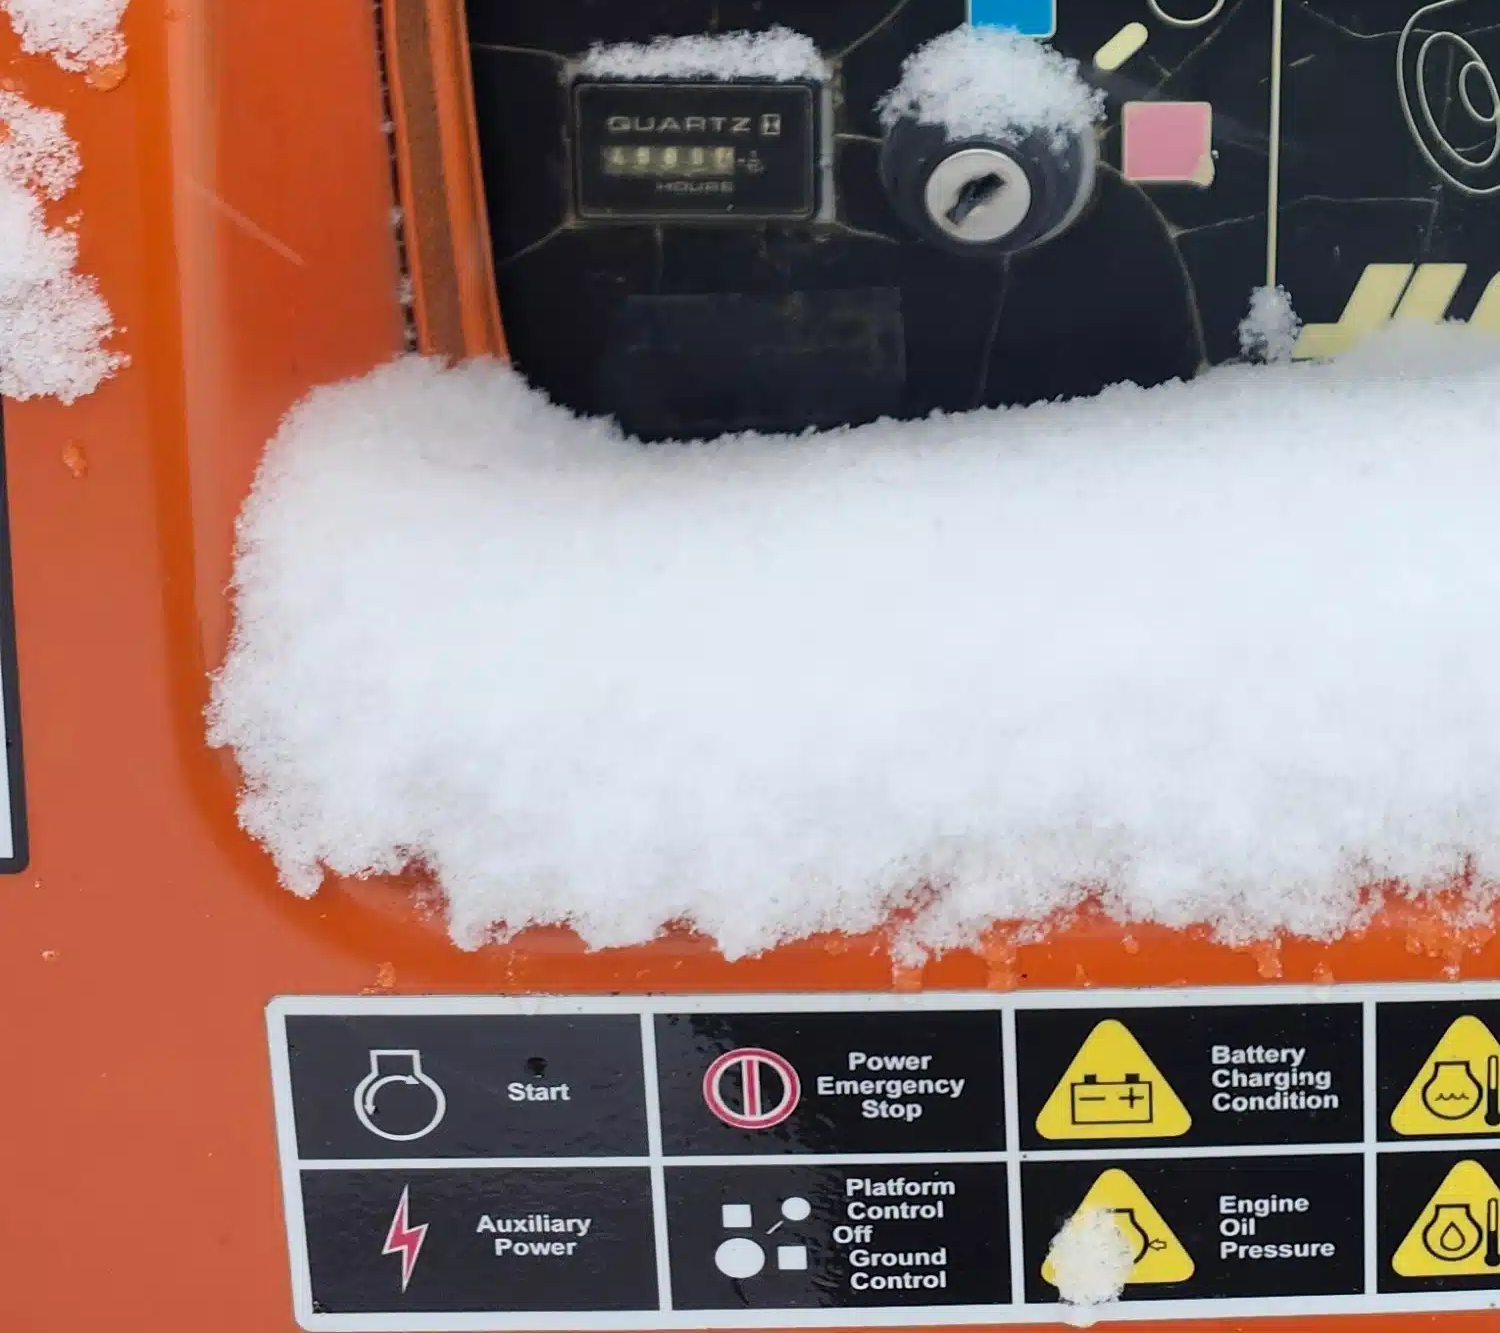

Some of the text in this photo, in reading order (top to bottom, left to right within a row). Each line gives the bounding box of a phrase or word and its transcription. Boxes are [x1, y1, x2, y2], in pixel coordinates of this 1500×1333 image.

[608, 117, 751, 133] QUARTZ
[849, 1053, 931, 1070] Power
[1213, 1046, 1305, 1066] Battery
[818, 1077, 964, 1098] Emergency
[1213, 1068, 1330, 1090] Charging
[508, 1083, 570, 1101] Start
[862, 1100, 921, 1121] Stop
[1213, 1092, 1338, 1111] Condition
[847, 1178, 955, 1196] Platform
[848, 1201, 943, 1219] Control
[1220, 1195, 1309, 1217] Engine
[477, 1215, 591, 1236] Auxiliary
[833, 1225, 872, 1243] Off
[1220, 1218, 1255, 1236] Oil
[495, 1239, 577, 1255] Power
[1221, 1242, 1334, 1258] Pressure
[850, 1248, 946, 1266] Ground
[851, 1271, 946, 1289] Control
